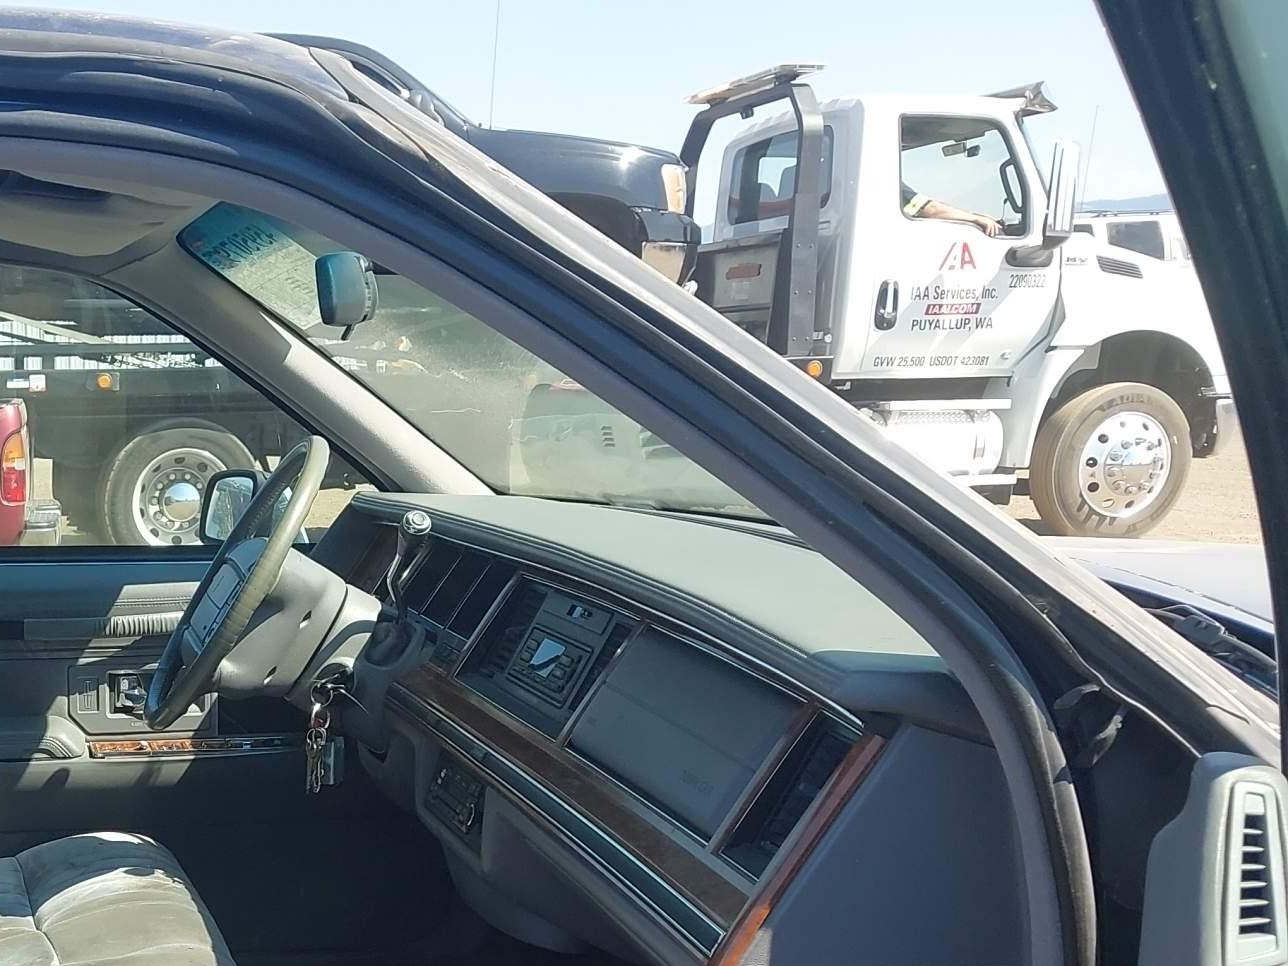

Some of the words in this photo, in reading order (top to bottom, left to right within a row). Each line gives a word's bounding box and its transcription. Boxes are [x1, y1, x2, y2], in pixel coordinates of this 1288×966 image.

[910, 286, 930, 301] IAA
[933, 285, 980, 302] Services,
[981, 285, 999, 299] Inc.
[911, 317, 972, 331] PUYALLUP,
[975, 317, 993, 329] WA
[873, 356, 896, 368] GVW
[929, 356, 959, 367] USDOT
